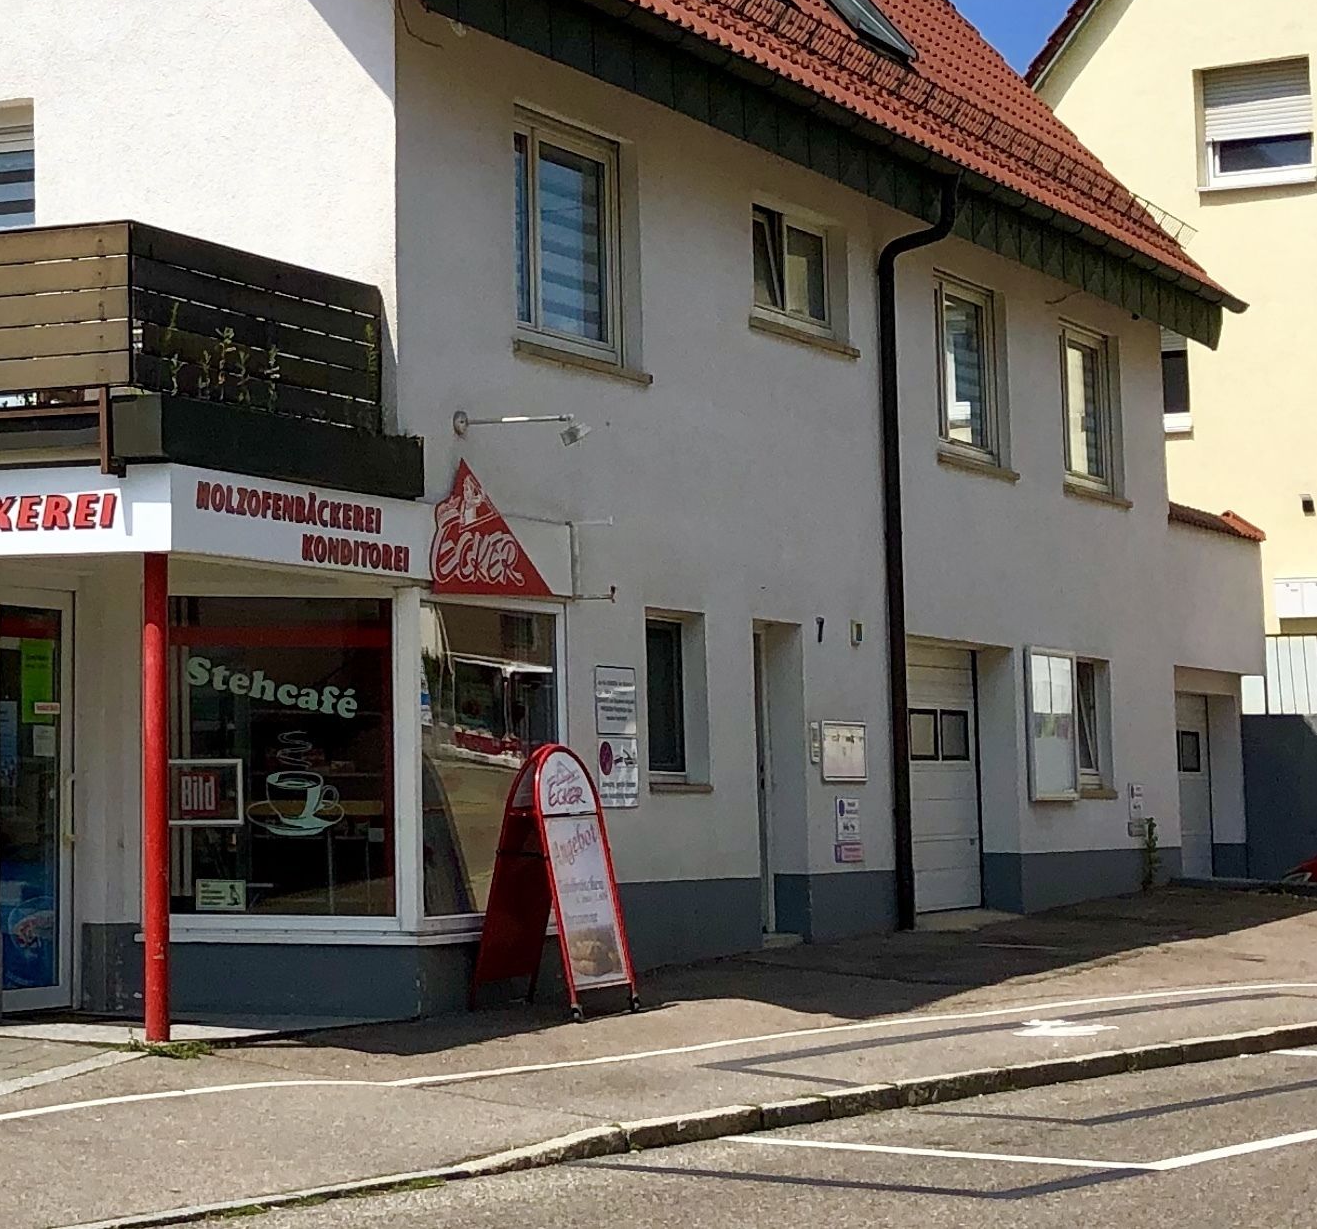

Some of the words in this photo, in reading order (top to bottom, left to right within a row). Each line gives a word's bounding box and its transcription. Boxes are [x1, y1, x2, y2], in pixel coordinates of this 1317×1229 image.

[196, 481, 382, 534] HOLZOFENBÄCKEREI
[301, 533, 410, 573] KONDITOREI
[186, 656, 358, 719] Stehcafé
